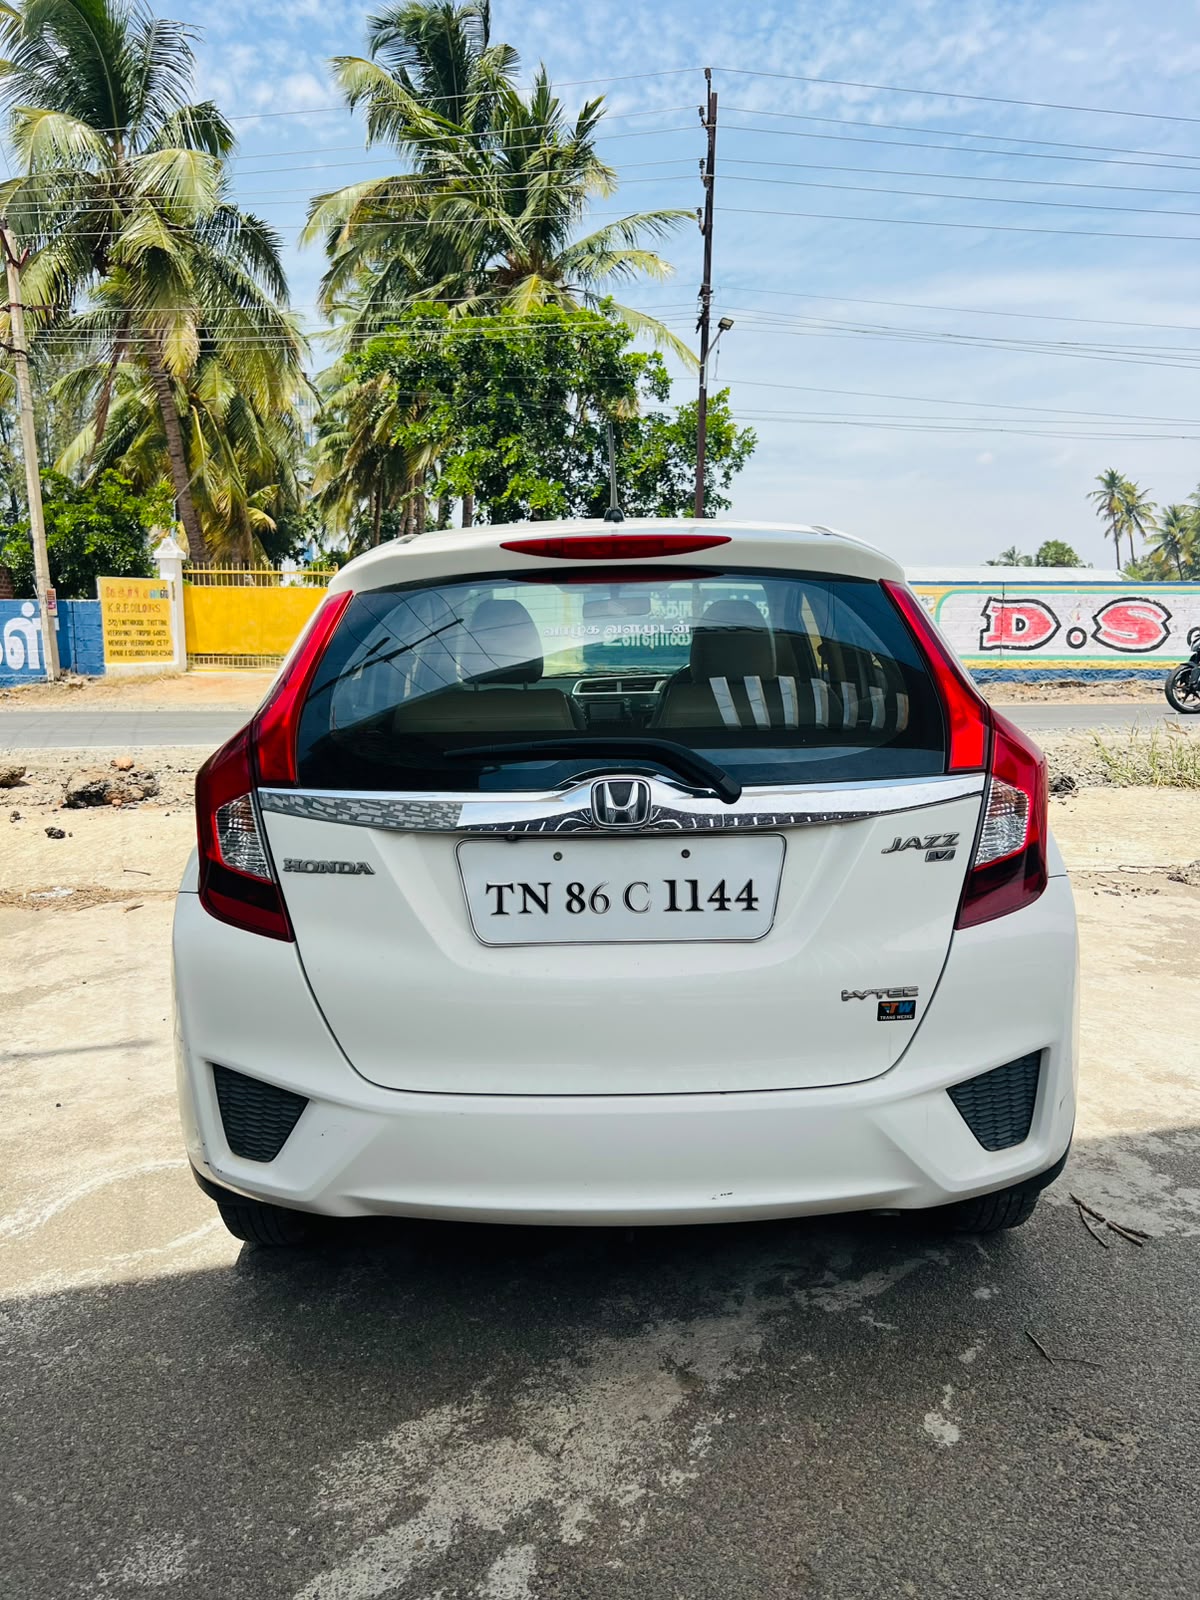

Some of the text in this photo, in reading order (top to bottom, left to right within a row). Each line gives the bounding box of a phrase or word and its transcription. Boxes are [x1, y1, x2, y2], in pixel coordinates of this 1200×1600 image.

[543, 619, 692, 639] வாழ்க வளமுடன்
[881, 832, 960, 854] JAZZ
[283, 857, 375, 875] HONDA
[485, 878, 759, 915] TN 86 C 1144
